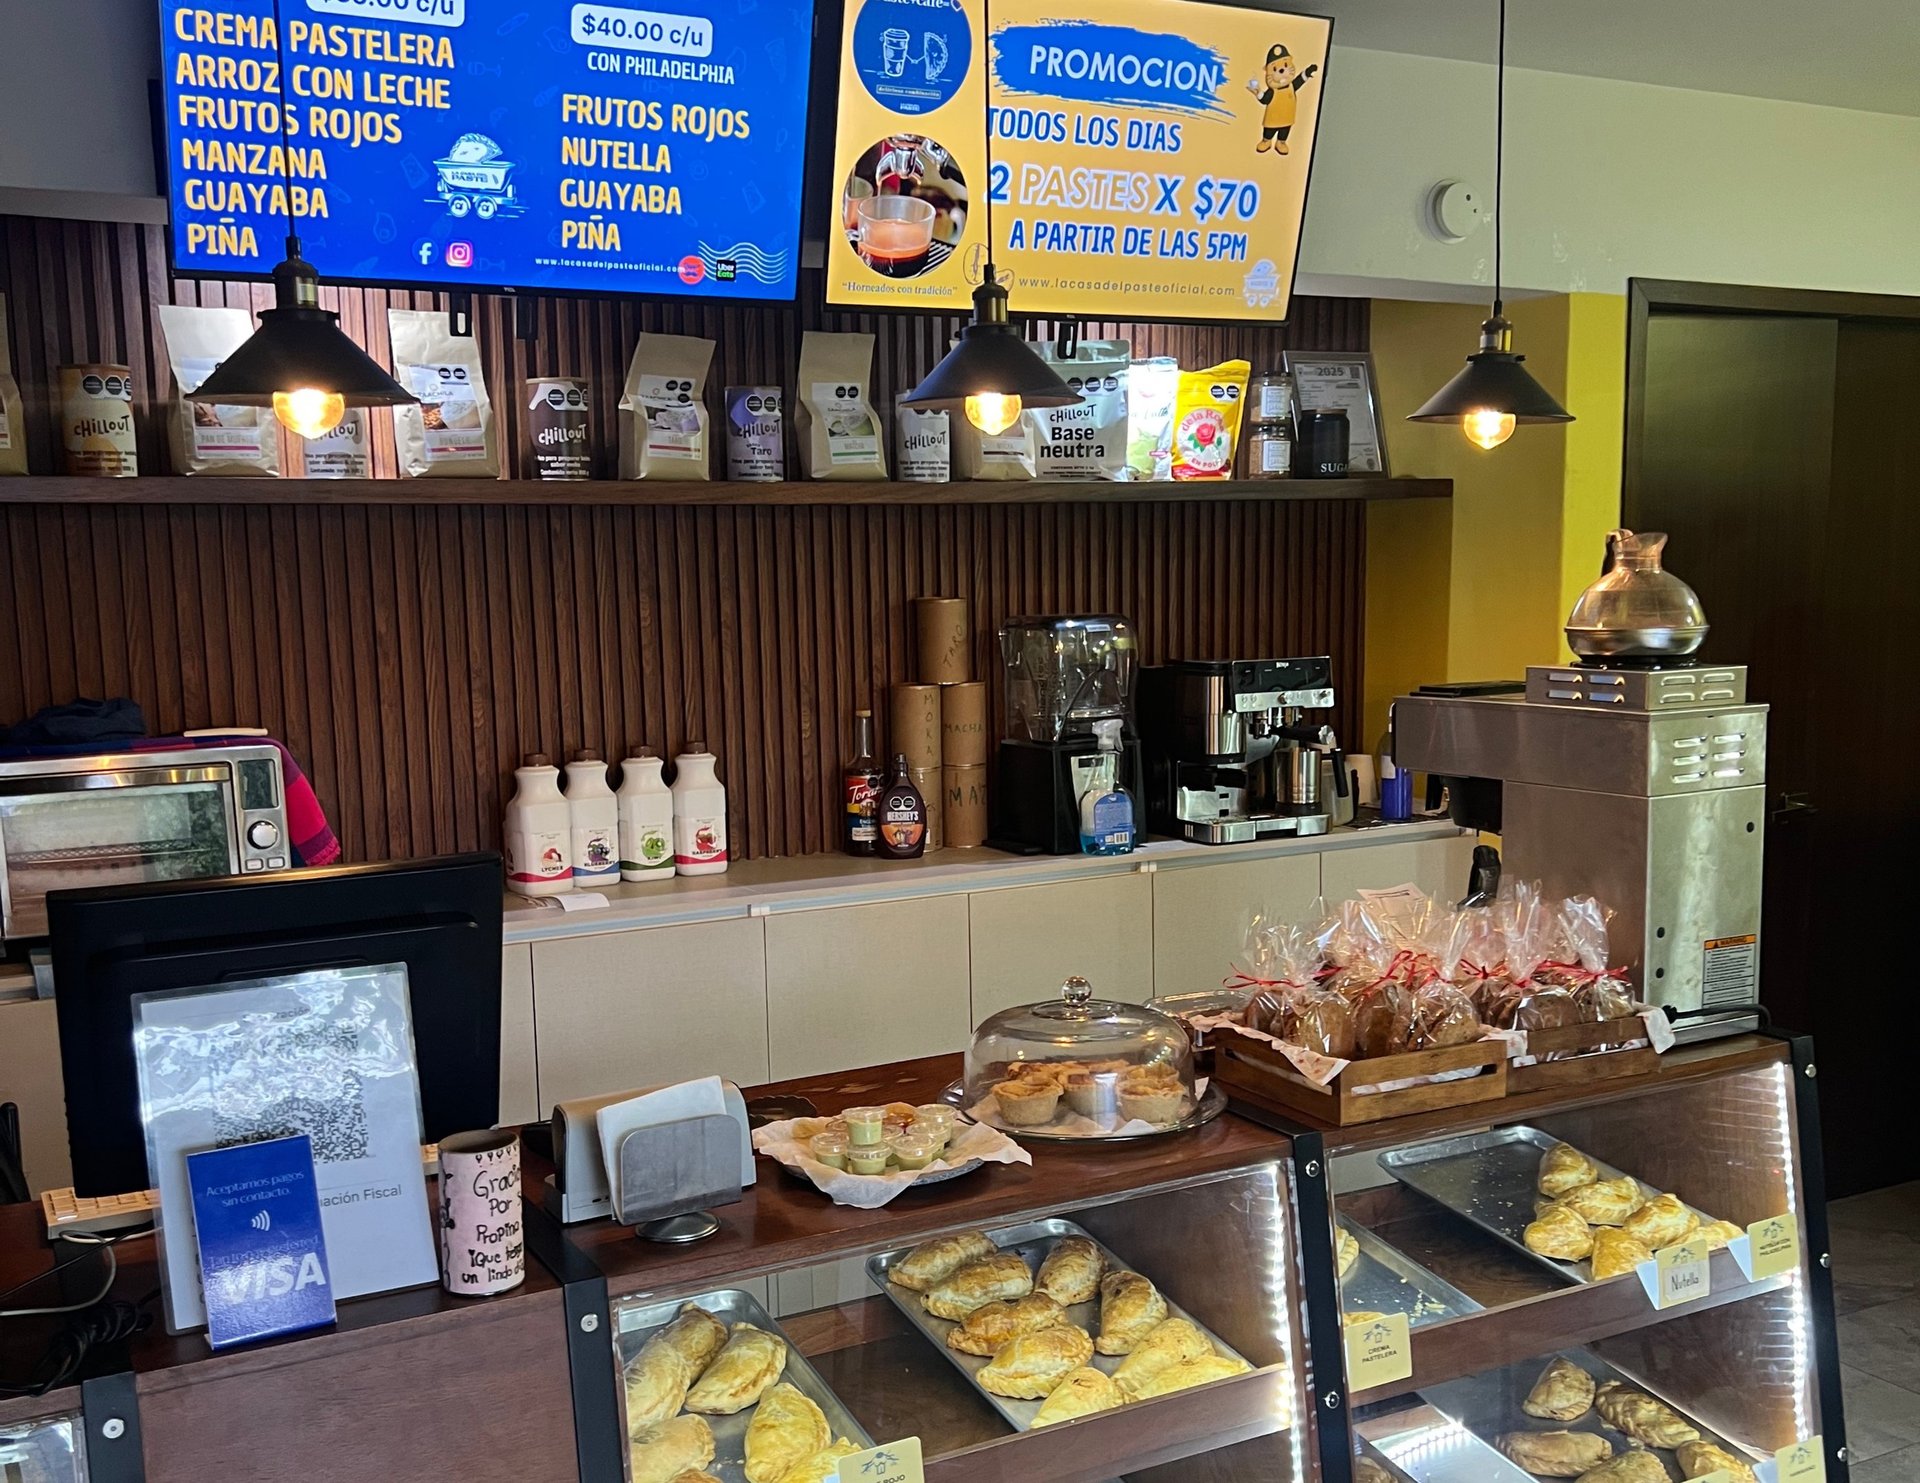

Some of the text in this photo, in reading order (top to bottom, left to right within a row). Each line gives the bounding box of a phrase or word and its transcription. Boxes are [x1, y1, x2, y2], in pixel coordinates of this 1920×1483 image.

[175, 8, 454, 69] CREMA PASTELERA
[581, 12, 703, 48] $40.00 c/u
[176, 52, 451, 109] ARROZ CON LECHE
[587, 51, 735, 85] CON PHILADELPHIA
[1030, 44, 1218, 91] PROMOCION
[178, 94, 402, 148] FRUTOS ROJOS
[562, 94, 750, 143] FRUTOS ROJOS
[987, 107, 1182, 152] TODOS LOS DIAS
[182, 138, 327, 180] MANZANA
[562, 136, 671, 173] NUTELLA
[184, 179, 328, 218] GUAYABA
[560, 178, 682, 215] GUAYABA
[989, 164, 1261, 224] 2 PASTES X $70
[187, 217, 259, 257] PIÑA
[561, 214, 621, 252] PIÑA
[1009, 220, 1248, 261] A PARTIR DE LAS 5PM
[535, 257, 686, 273] www.lacasadelpasteoficial.com
[717, 262, 735, 272] Uber
[898, 285, 912, 296] con
[1019, 277, 1236, 297] www.lacasadelpasteoficial.com
[1317, 366, 1345, 378] 2025
[1040, 442, 1106, 459] neutra
[1051, 427, 1095, 441] Base
[750, 447, 773, 456] Taro
[943, 624, 964, 668] TARO
[923, 693, 936, 756] MOKA
[206, 1170, 305, 1197] Aceptamos pagos
[363, 1183, 402, 1200] Fiscal
[221, 1197, 239, 1208] sin
[488, 1197, 512, 1218] Por
[476, 1220, 520, 1245] Propina
[220, 1252, 327, 1306] VISA
[461, 1272, 479, 1285] un
[488, 1264, 512, 1282] lindo
[1671, 1269, 1700, 1292] Nutella
[1362, 1350, 1397, 1363] PASTELERA
[1368, 1345, 1391, 1355] CREMA
[883, 1474, 906, 1483] ROJO
